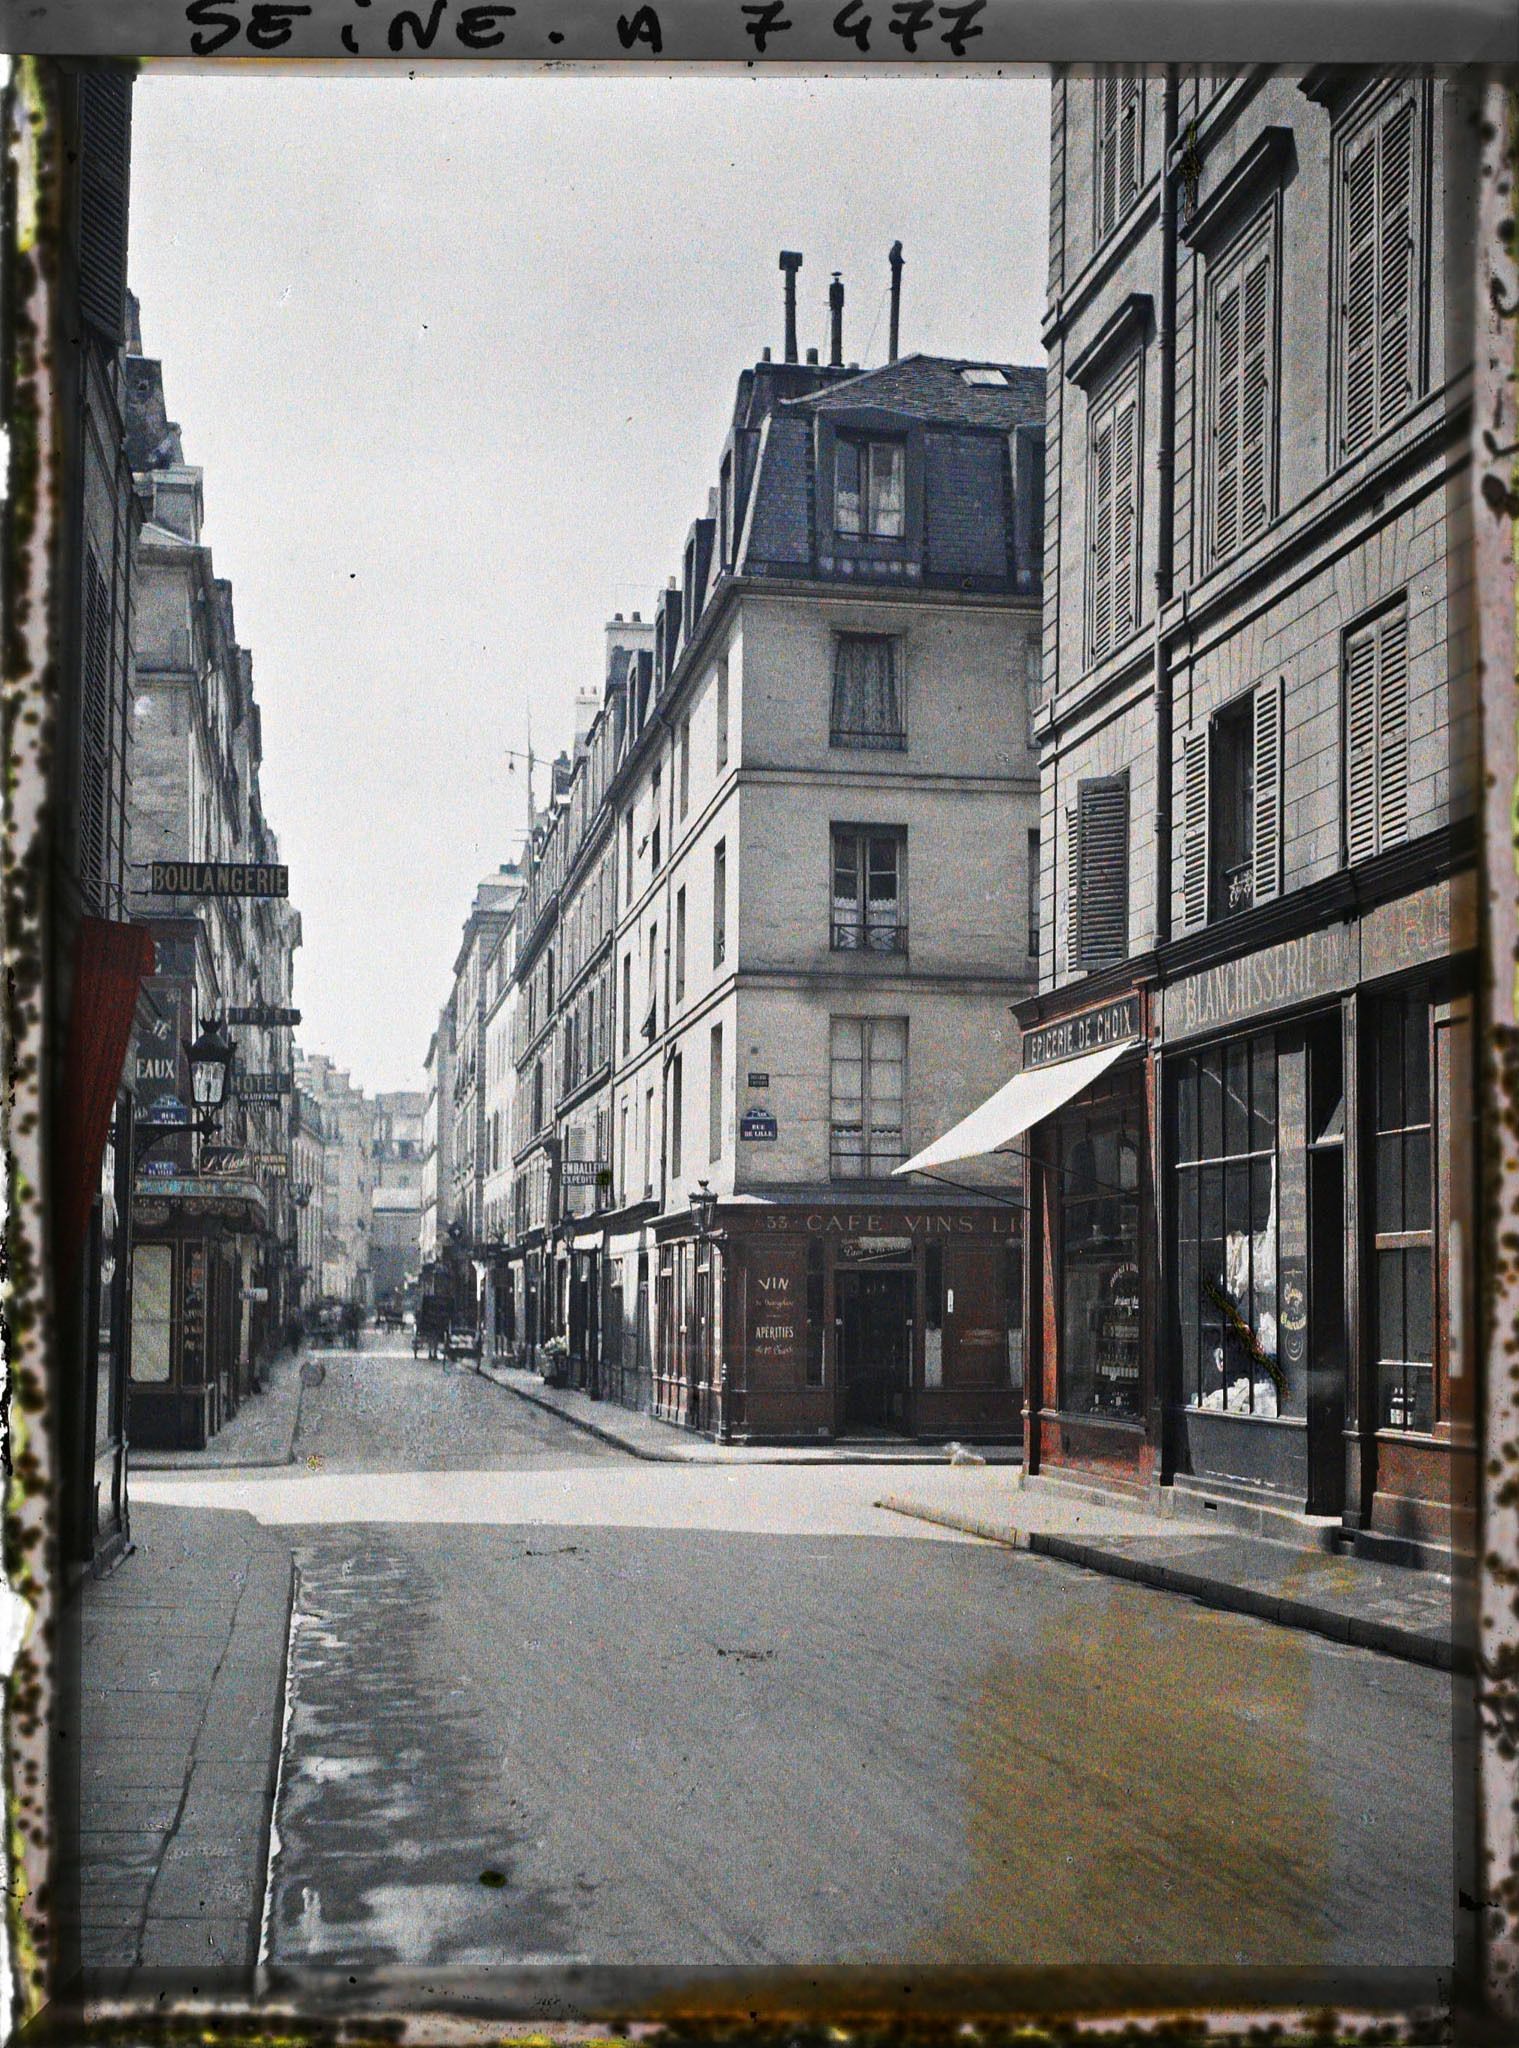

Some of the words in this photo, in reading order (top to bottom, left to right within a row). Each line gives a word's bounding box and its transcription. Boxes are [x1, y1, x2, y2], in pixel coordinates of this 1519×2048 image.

[617, 4, 663, 53] A
[153, 865, 287, 894] BOULANGERIE
[1184, 934, 1316, 1031] BLANCHISSERIE
[1031, 1021, 1073, 1064] EPICERIE
[1078, 1017, 1091, 1050] DE
[1097, 1004, 1132, 1043] CHOIX
[806, 1214, 883, 1233] CAFE
[904, 1215, 973, 1233] VINS
[758, 1277, 790, 1291] VIN
